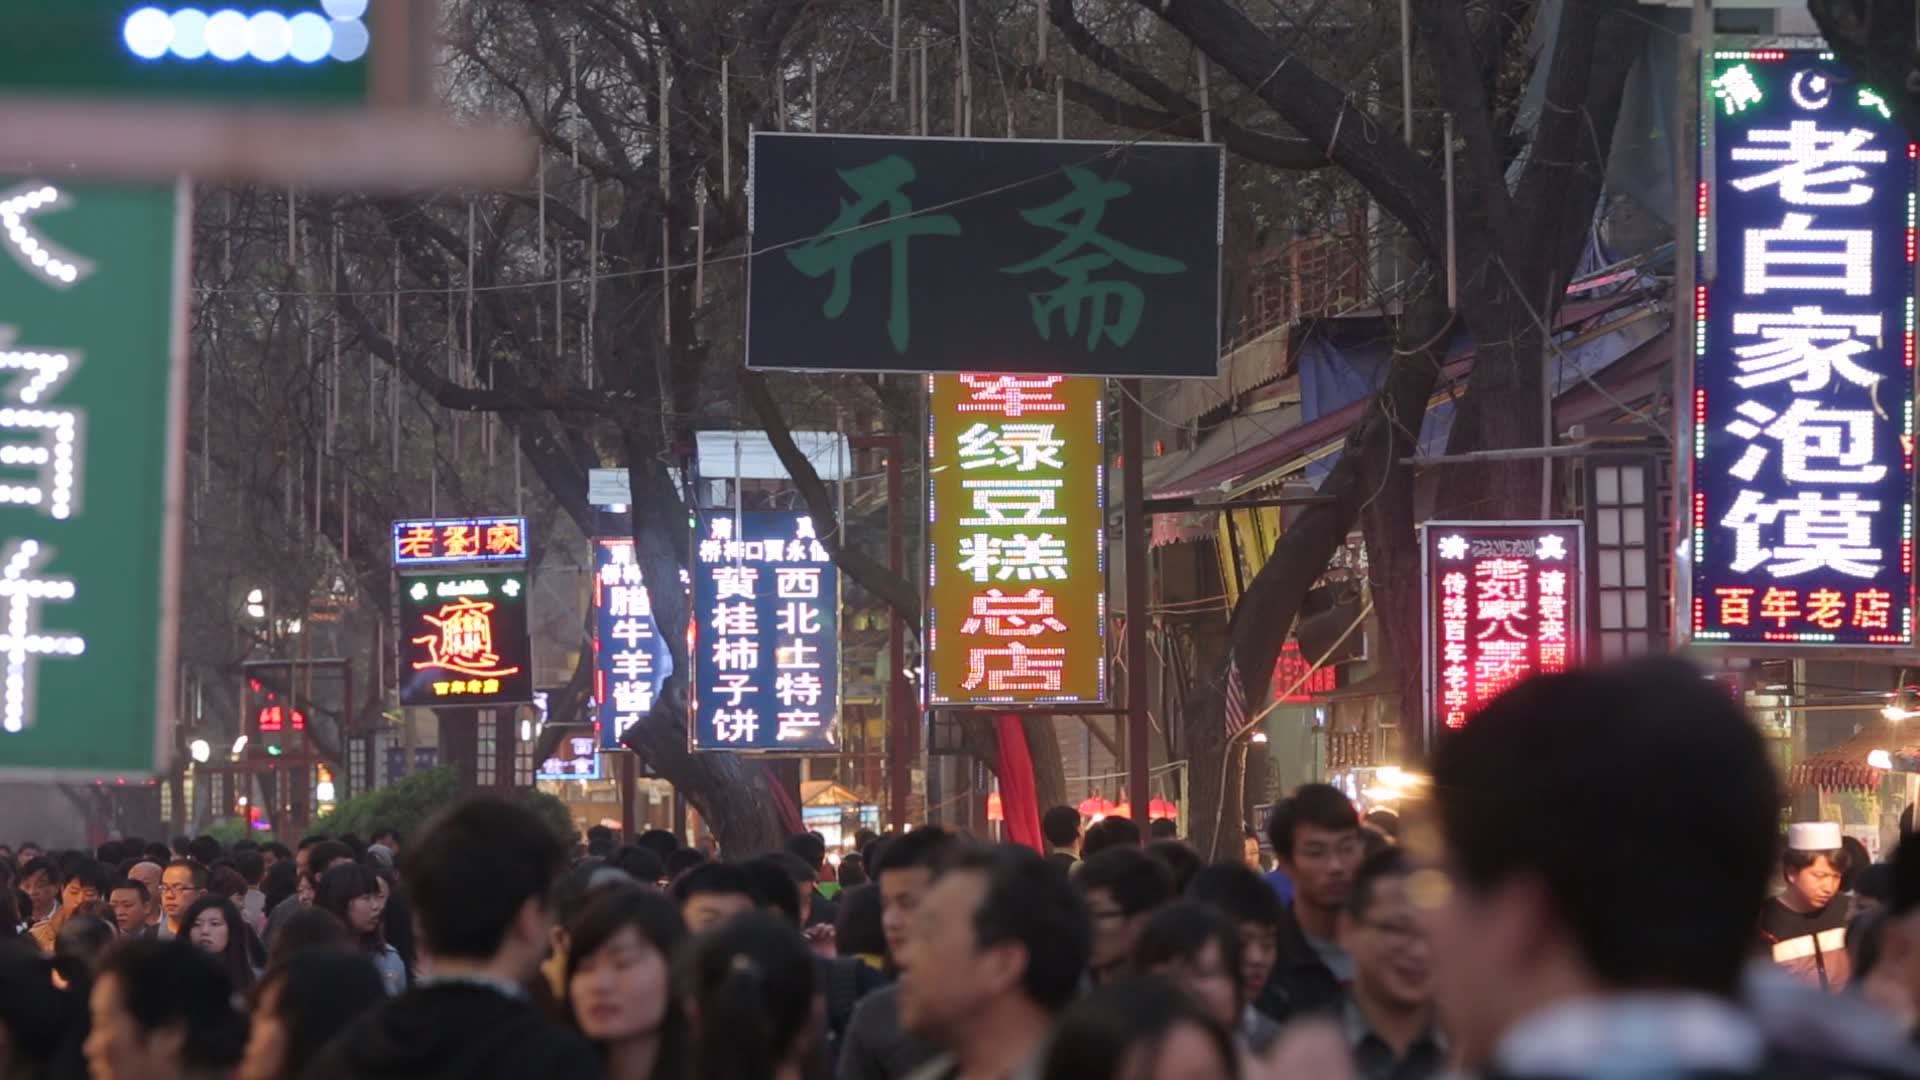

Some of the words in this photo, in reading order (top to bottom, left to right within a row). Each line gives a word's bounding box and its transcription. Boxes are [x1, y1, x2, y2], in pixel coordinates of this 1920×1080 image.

[785, 154, 1188, 354] 开斋
[1721, 119, 1888, 580] 老白家泡馍
[711, 566, 760, 743] 黄桂柿子饼
[775, 566, 822, 742] 西北土特产
[1714, 586, 1892, 630] 百年老店
